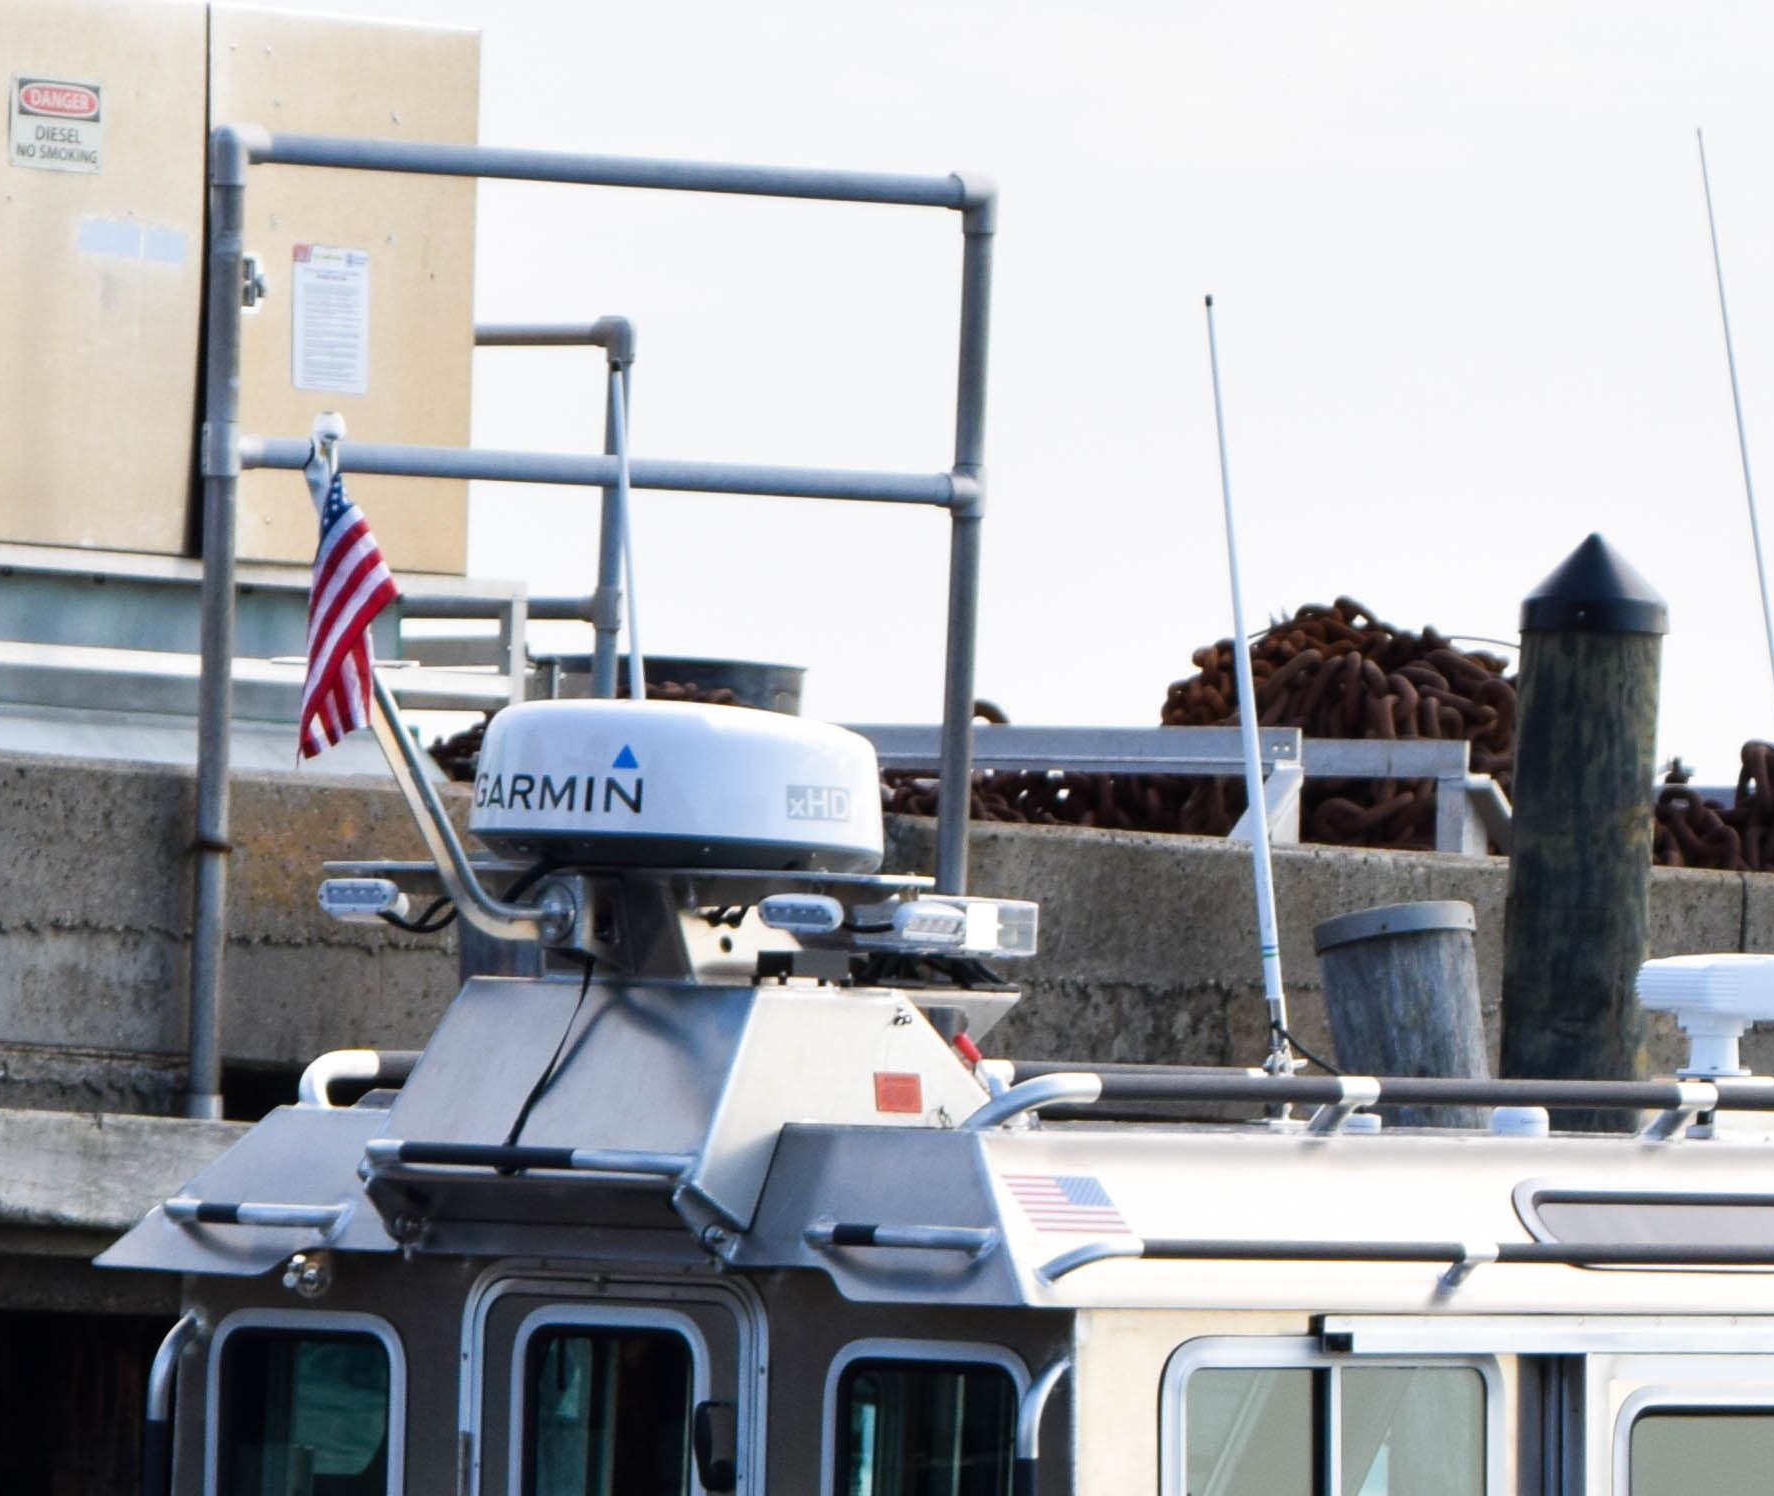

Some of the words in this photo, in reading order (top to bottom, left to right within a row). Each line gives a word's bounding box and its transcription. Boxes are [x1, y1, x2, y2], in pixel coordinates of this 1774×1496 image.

[30, 88, 90, 112] DANGER
[34, 125, 82, 144] DIESEL
[16, 143, 35, 158] NO
[39, 144, 98, 164] SMOKING
[476, 773, 643, 814] GARMIN
[788, 787, 851, 819] xHD
